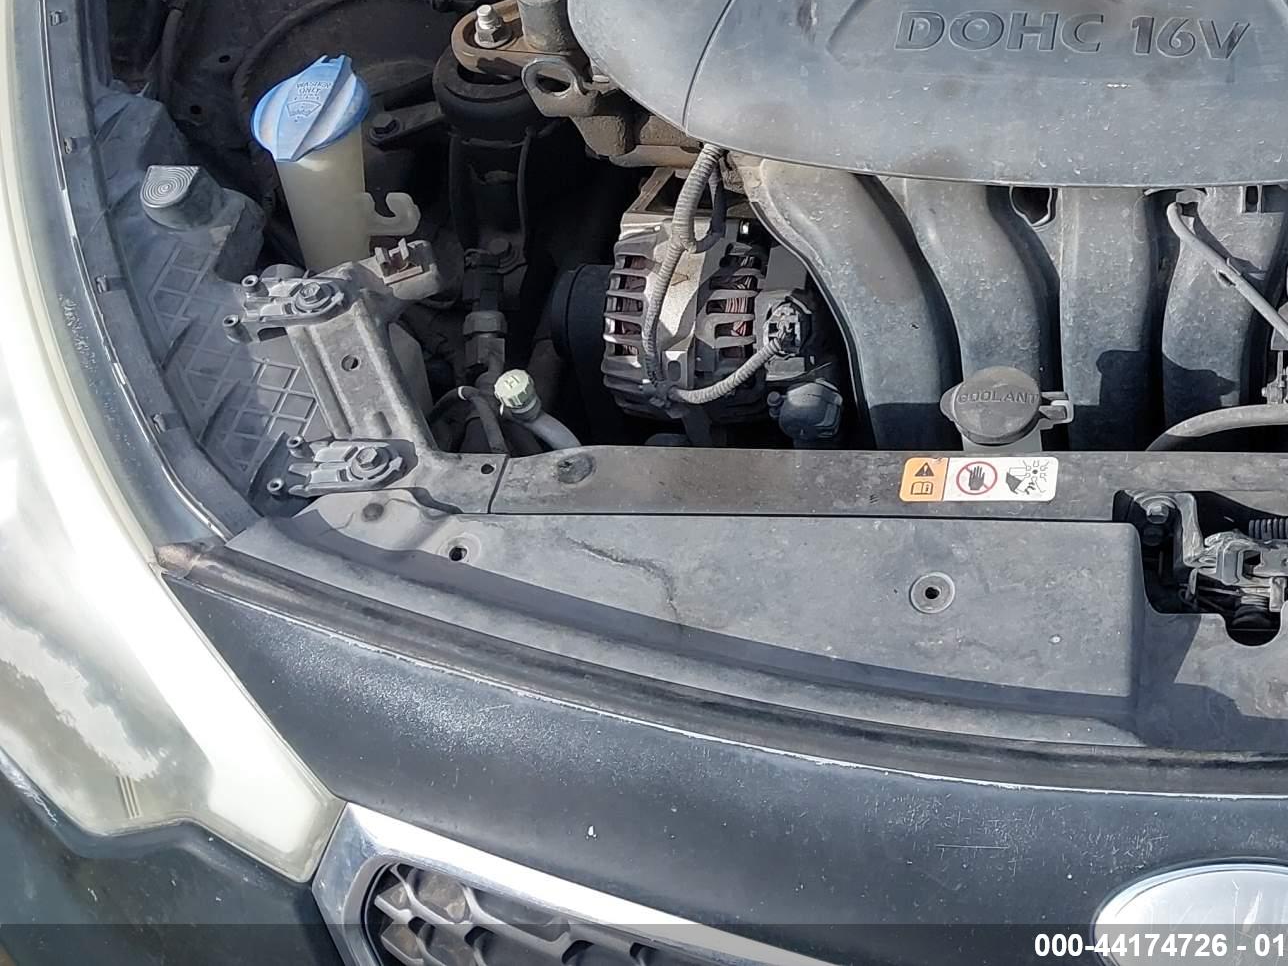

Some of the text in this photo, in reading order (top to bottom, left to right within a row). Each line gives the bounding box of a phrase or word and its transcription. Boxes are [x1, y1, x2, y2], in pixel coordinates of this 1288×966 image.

[894, 10, 1250, 60] DOHC 16V
[956, 389, 1039, 404] COOLANT
